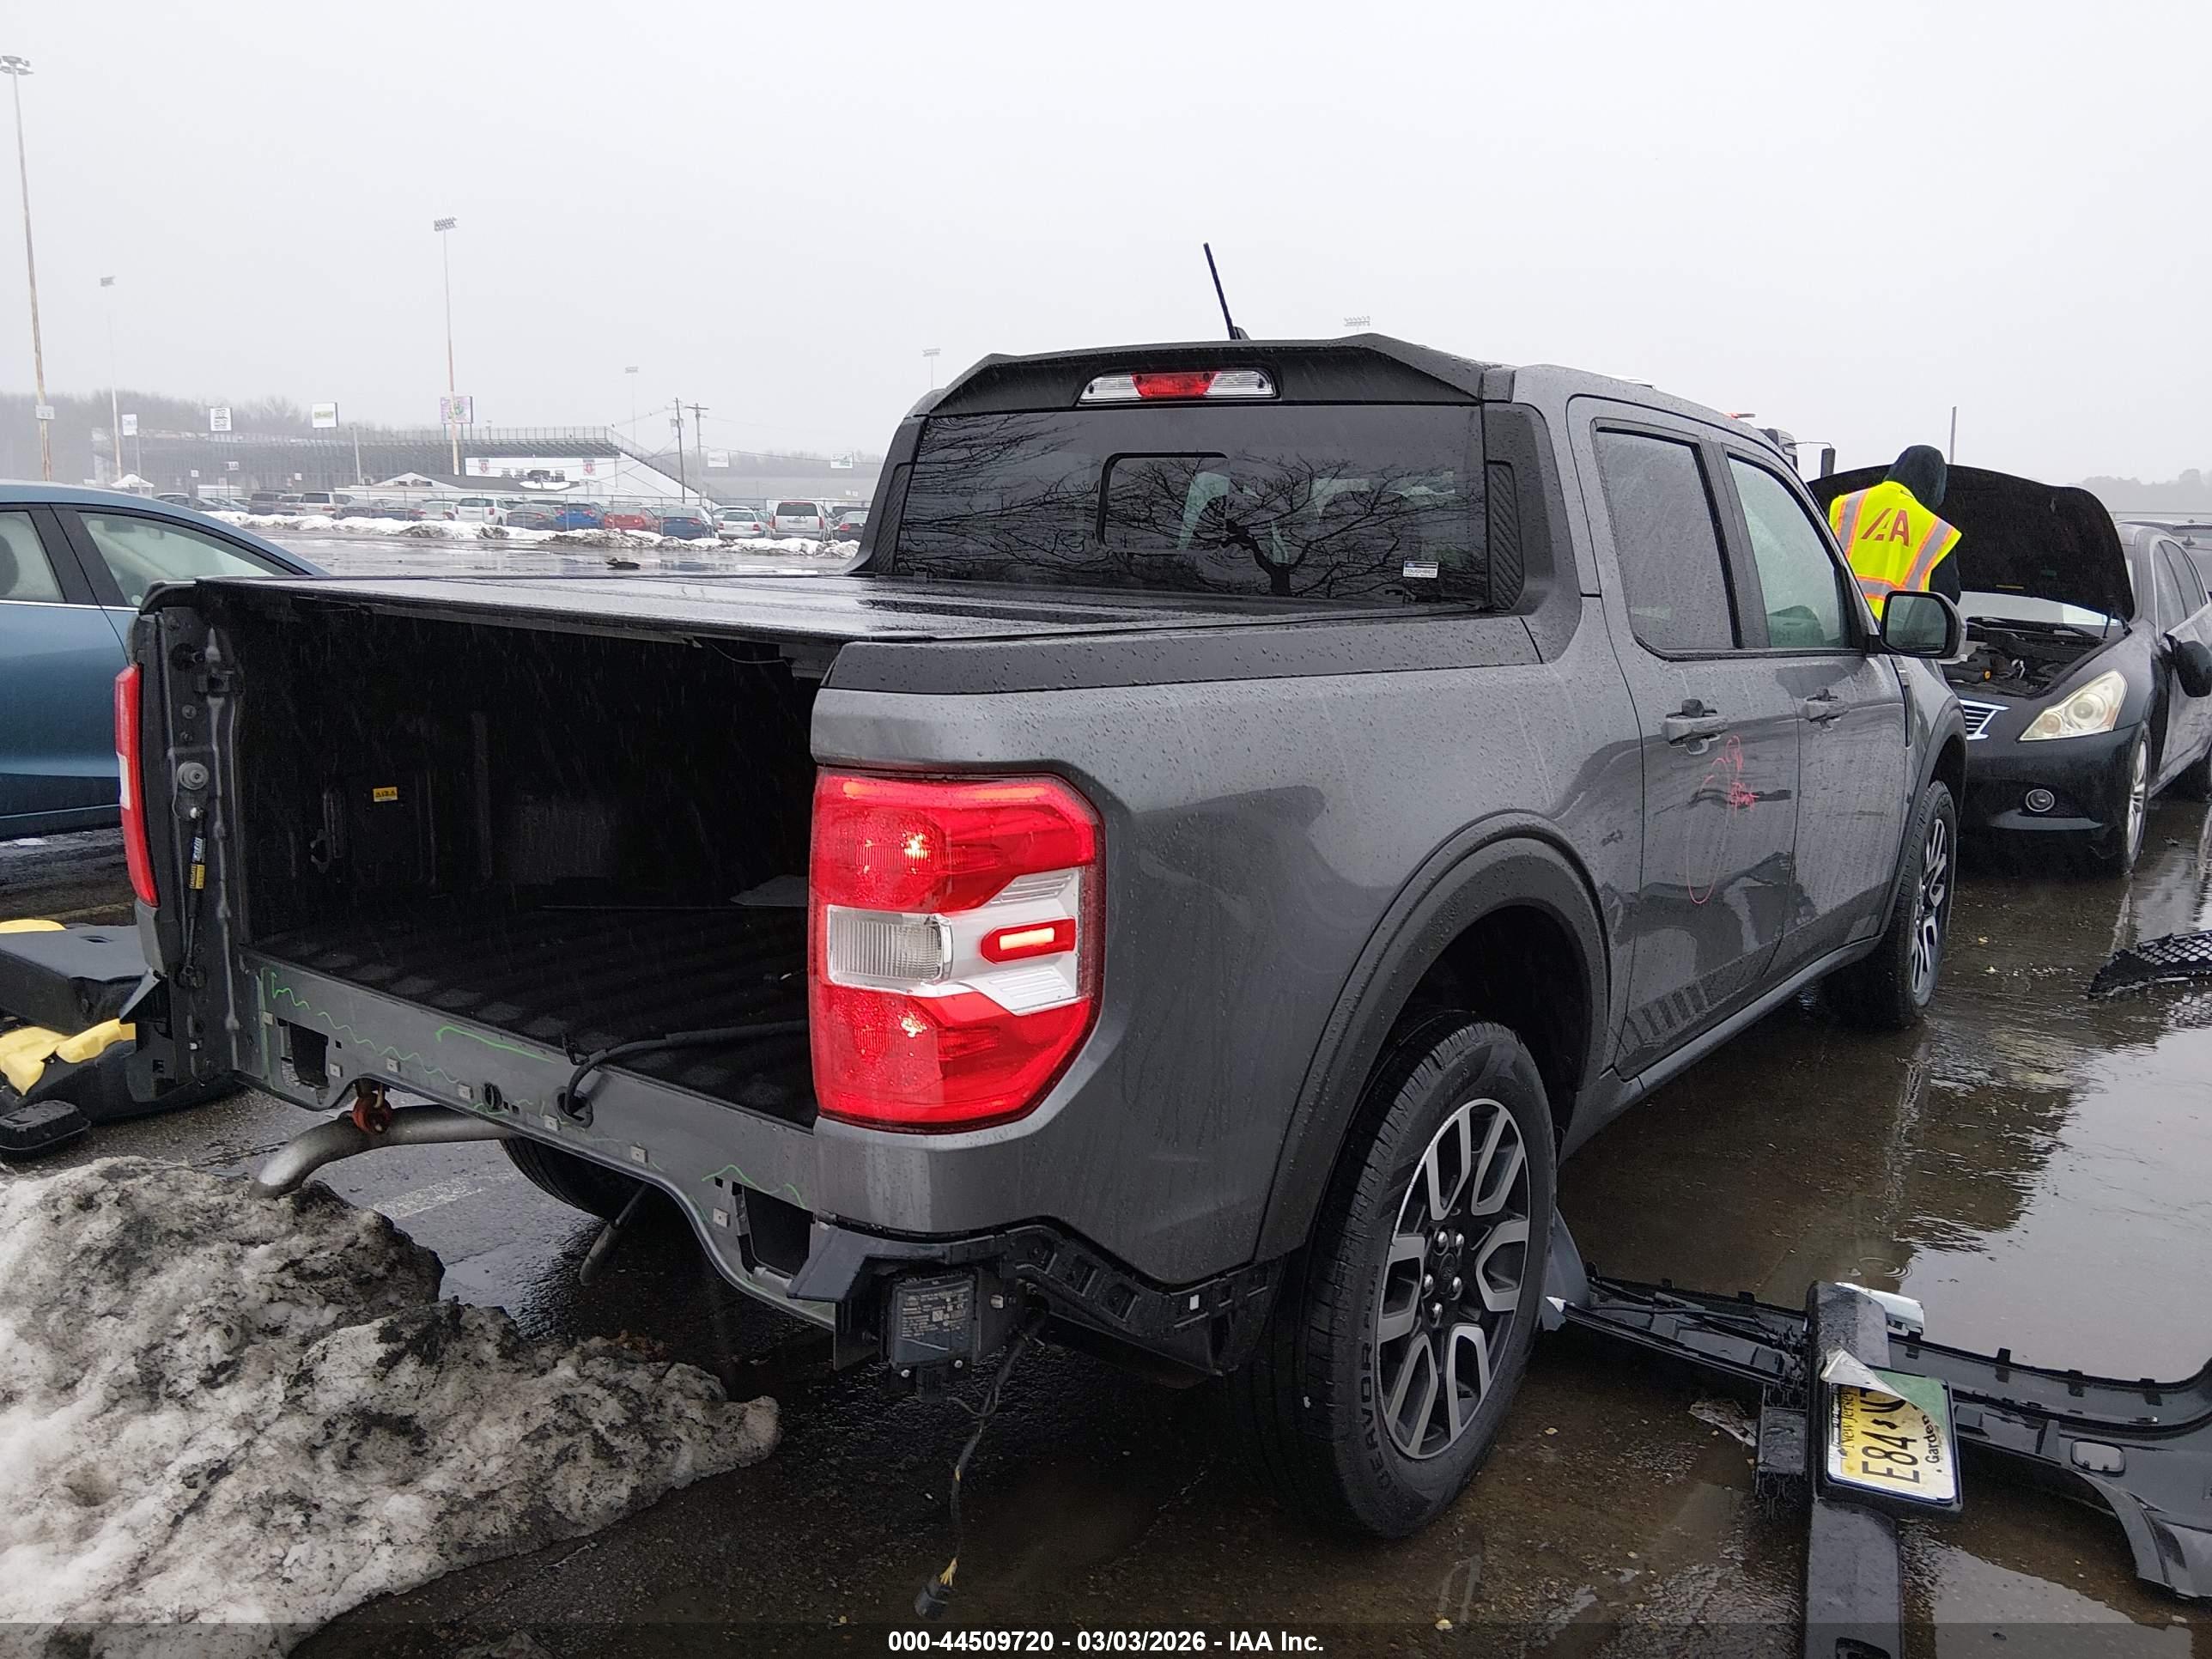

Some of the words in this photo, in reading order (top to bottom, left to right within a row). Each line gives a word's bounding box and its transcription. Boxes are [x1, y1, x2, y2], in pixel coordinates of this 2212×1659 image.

[1840, 1389, 1859, 1423] Jersey
[1840, 1424, 1855, 1449] New
[1861, 1431, 1921, 1484] E84
[1921, 1413, 1941, 1464] Garden
